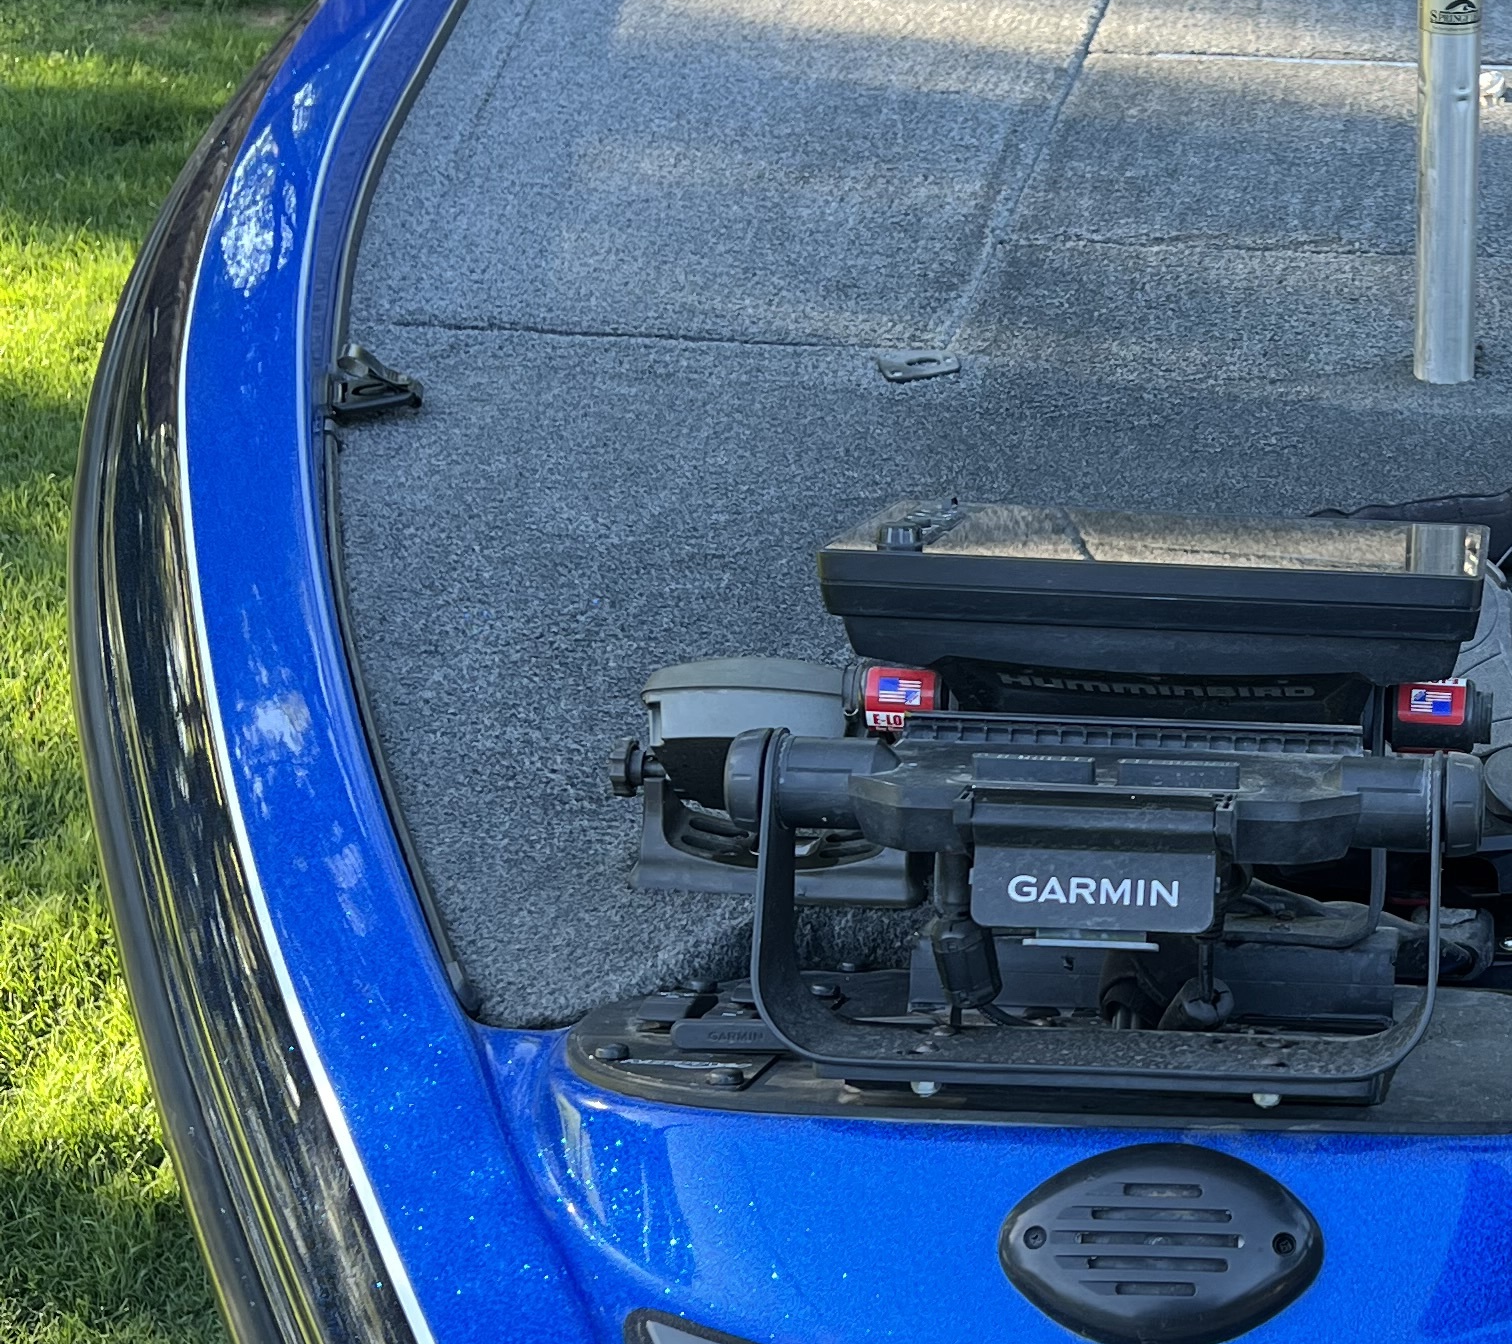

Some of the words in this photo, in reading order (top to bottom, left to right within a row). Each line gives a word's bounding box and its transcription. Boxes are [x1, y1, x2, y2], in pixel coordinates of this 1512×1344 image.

[998, 671, 1316, 698] HUMMINBIRD
[1007, 874, 1179, 908] GARMIN
[708, 1030, 764, 1043] GARMIN
